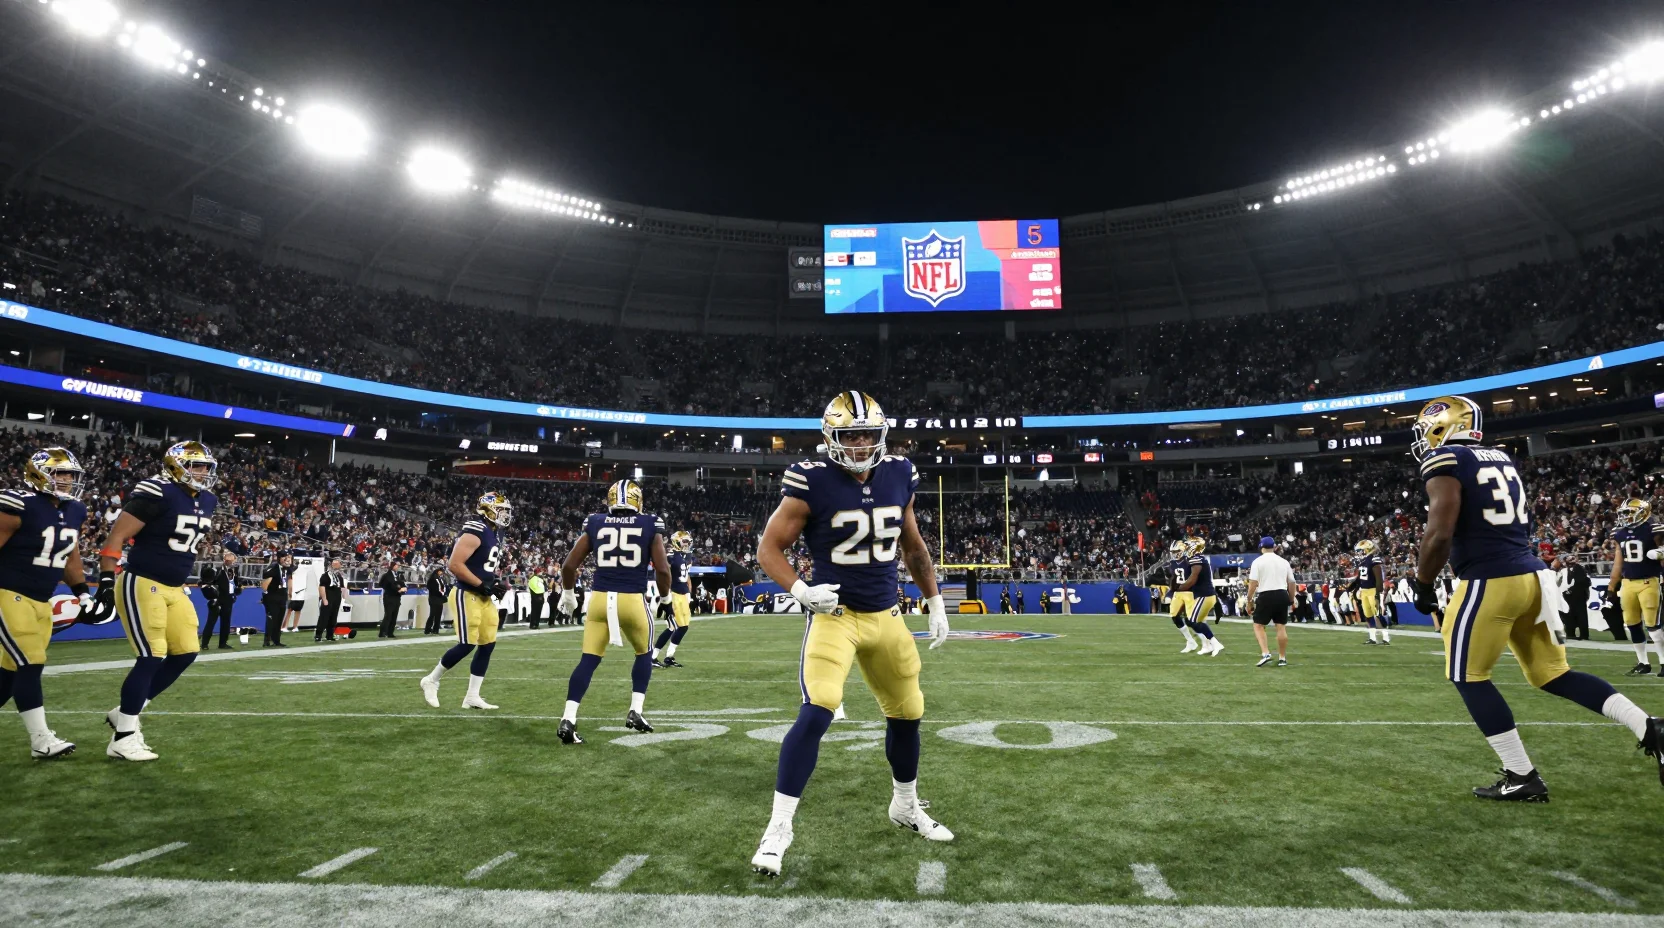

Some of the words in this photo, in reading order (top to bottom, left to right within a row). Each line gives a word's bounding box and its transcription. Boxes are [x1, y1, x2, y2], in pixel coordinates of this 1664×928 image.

[1027, 225, 1042, 245] 5
[912, 261, 958, 293] NFL
[1476, 466, 1529, 526] 32
[32, 525, 78, 568] 12
[596, 527, 643, 568] 25
[831, 505, 902, 565] 25
